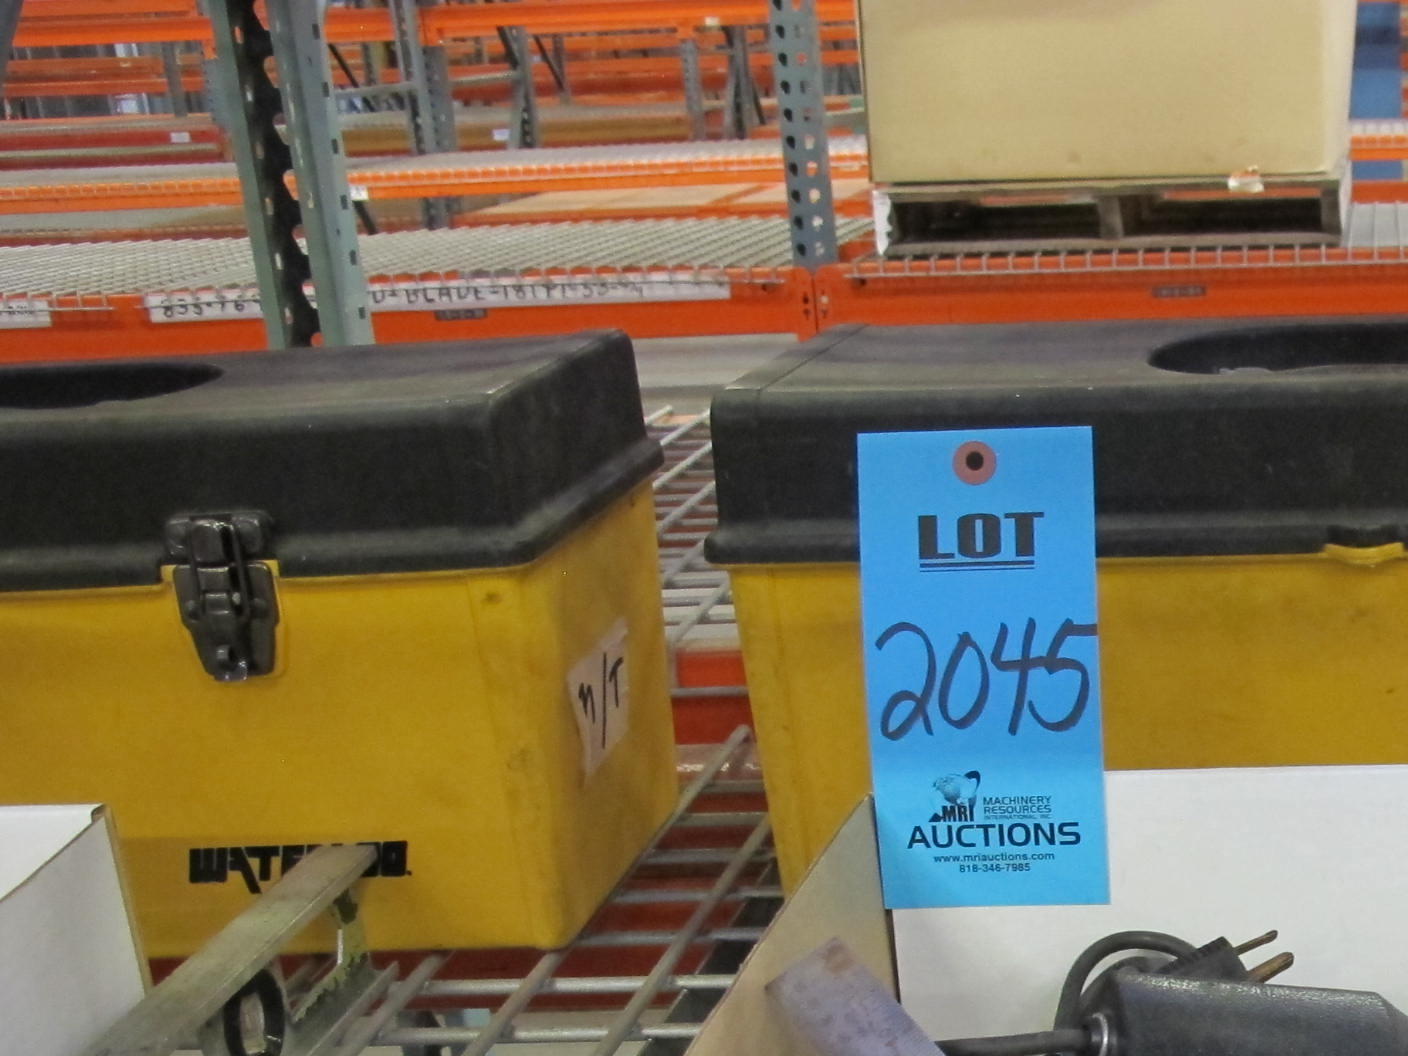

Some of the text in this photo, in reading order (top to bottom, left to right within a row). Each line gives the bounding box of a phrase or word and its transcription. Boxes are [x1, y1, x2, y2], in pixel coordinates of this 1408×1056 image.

[918, 511, 1045, 560] LOT
[875, 617, 1098, 741] 2045
[983, 795, 1052, 805] MACHINERY
[983, 804, 1052, 815] RESOURCES
[941, 803, 976, 823] MRI
[907, 821, 1081, 850] AUCTIONS
[933, 851, 1055, 863] www.mriauctions.com
